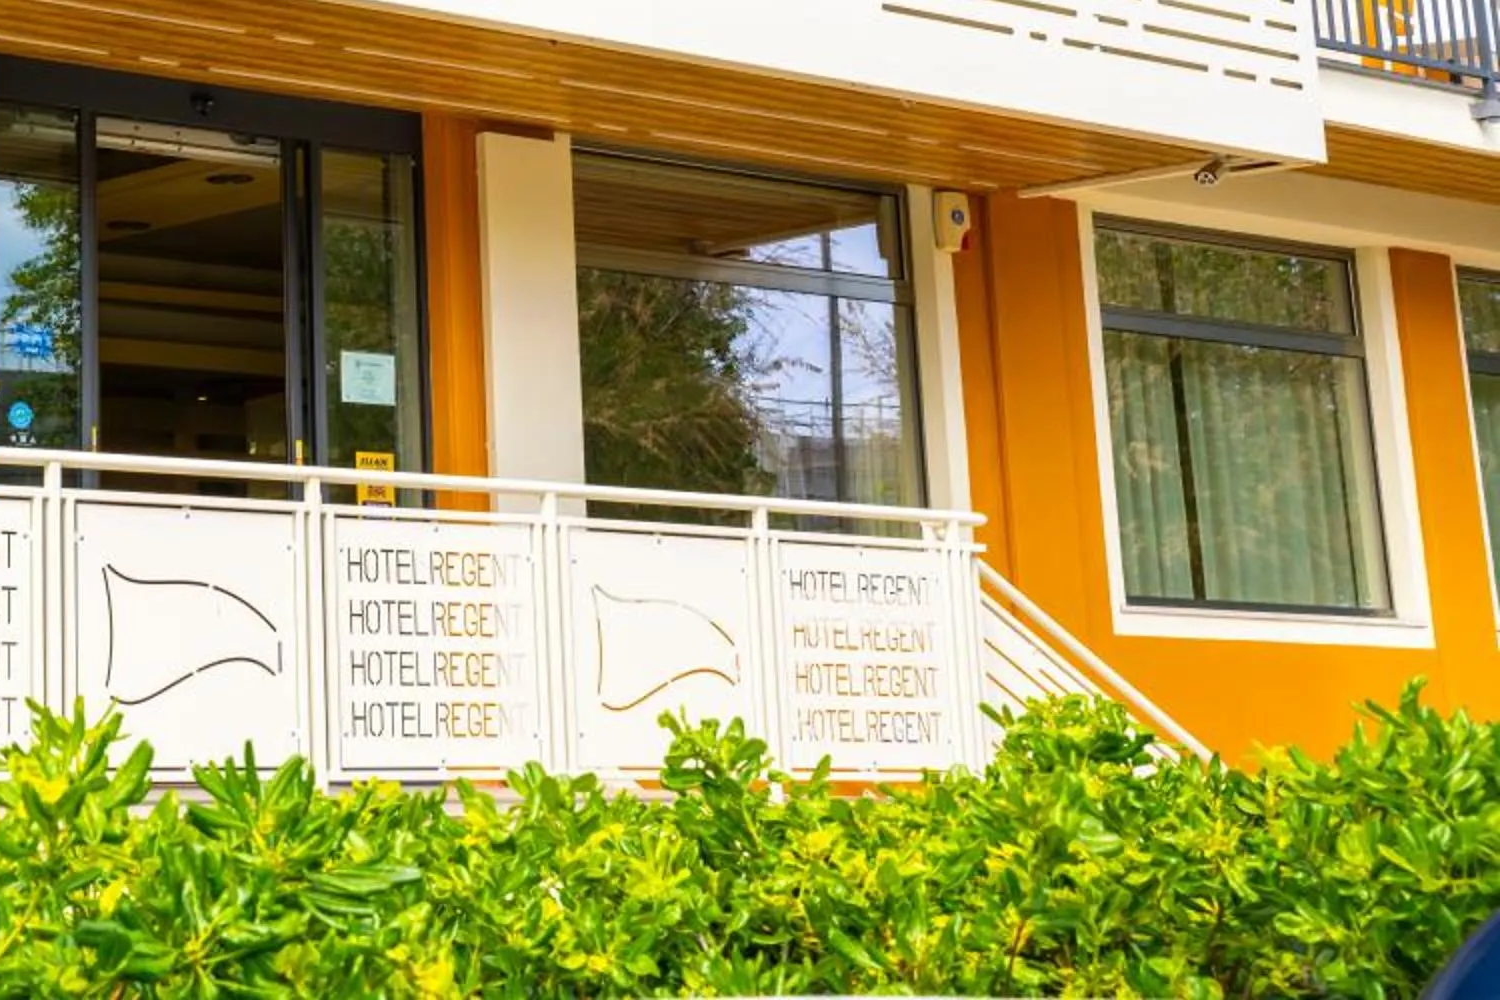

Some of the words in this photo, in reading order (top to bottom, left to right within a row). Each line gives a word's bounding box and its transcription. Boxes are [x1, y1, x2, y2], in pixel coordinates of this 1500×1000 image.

[347, 547, 427, 585] HOTEL
[430, 551, 521, 587] REGENT
[789, 568, 856, 602] HOTEL
[857, 574, 930, 605] REGENT
[349, 600, 429, 636] HOTEL
[350, 650, 431, 687] HOTEL
[794, 663, 861, 696] HOTEL
[863, 665, 939, 698] REGENT
[351, 701, 432, 738] HOTEL
[796, 708, 865, 742] HOTEL
[865, 710, 942, 744] REGENT
